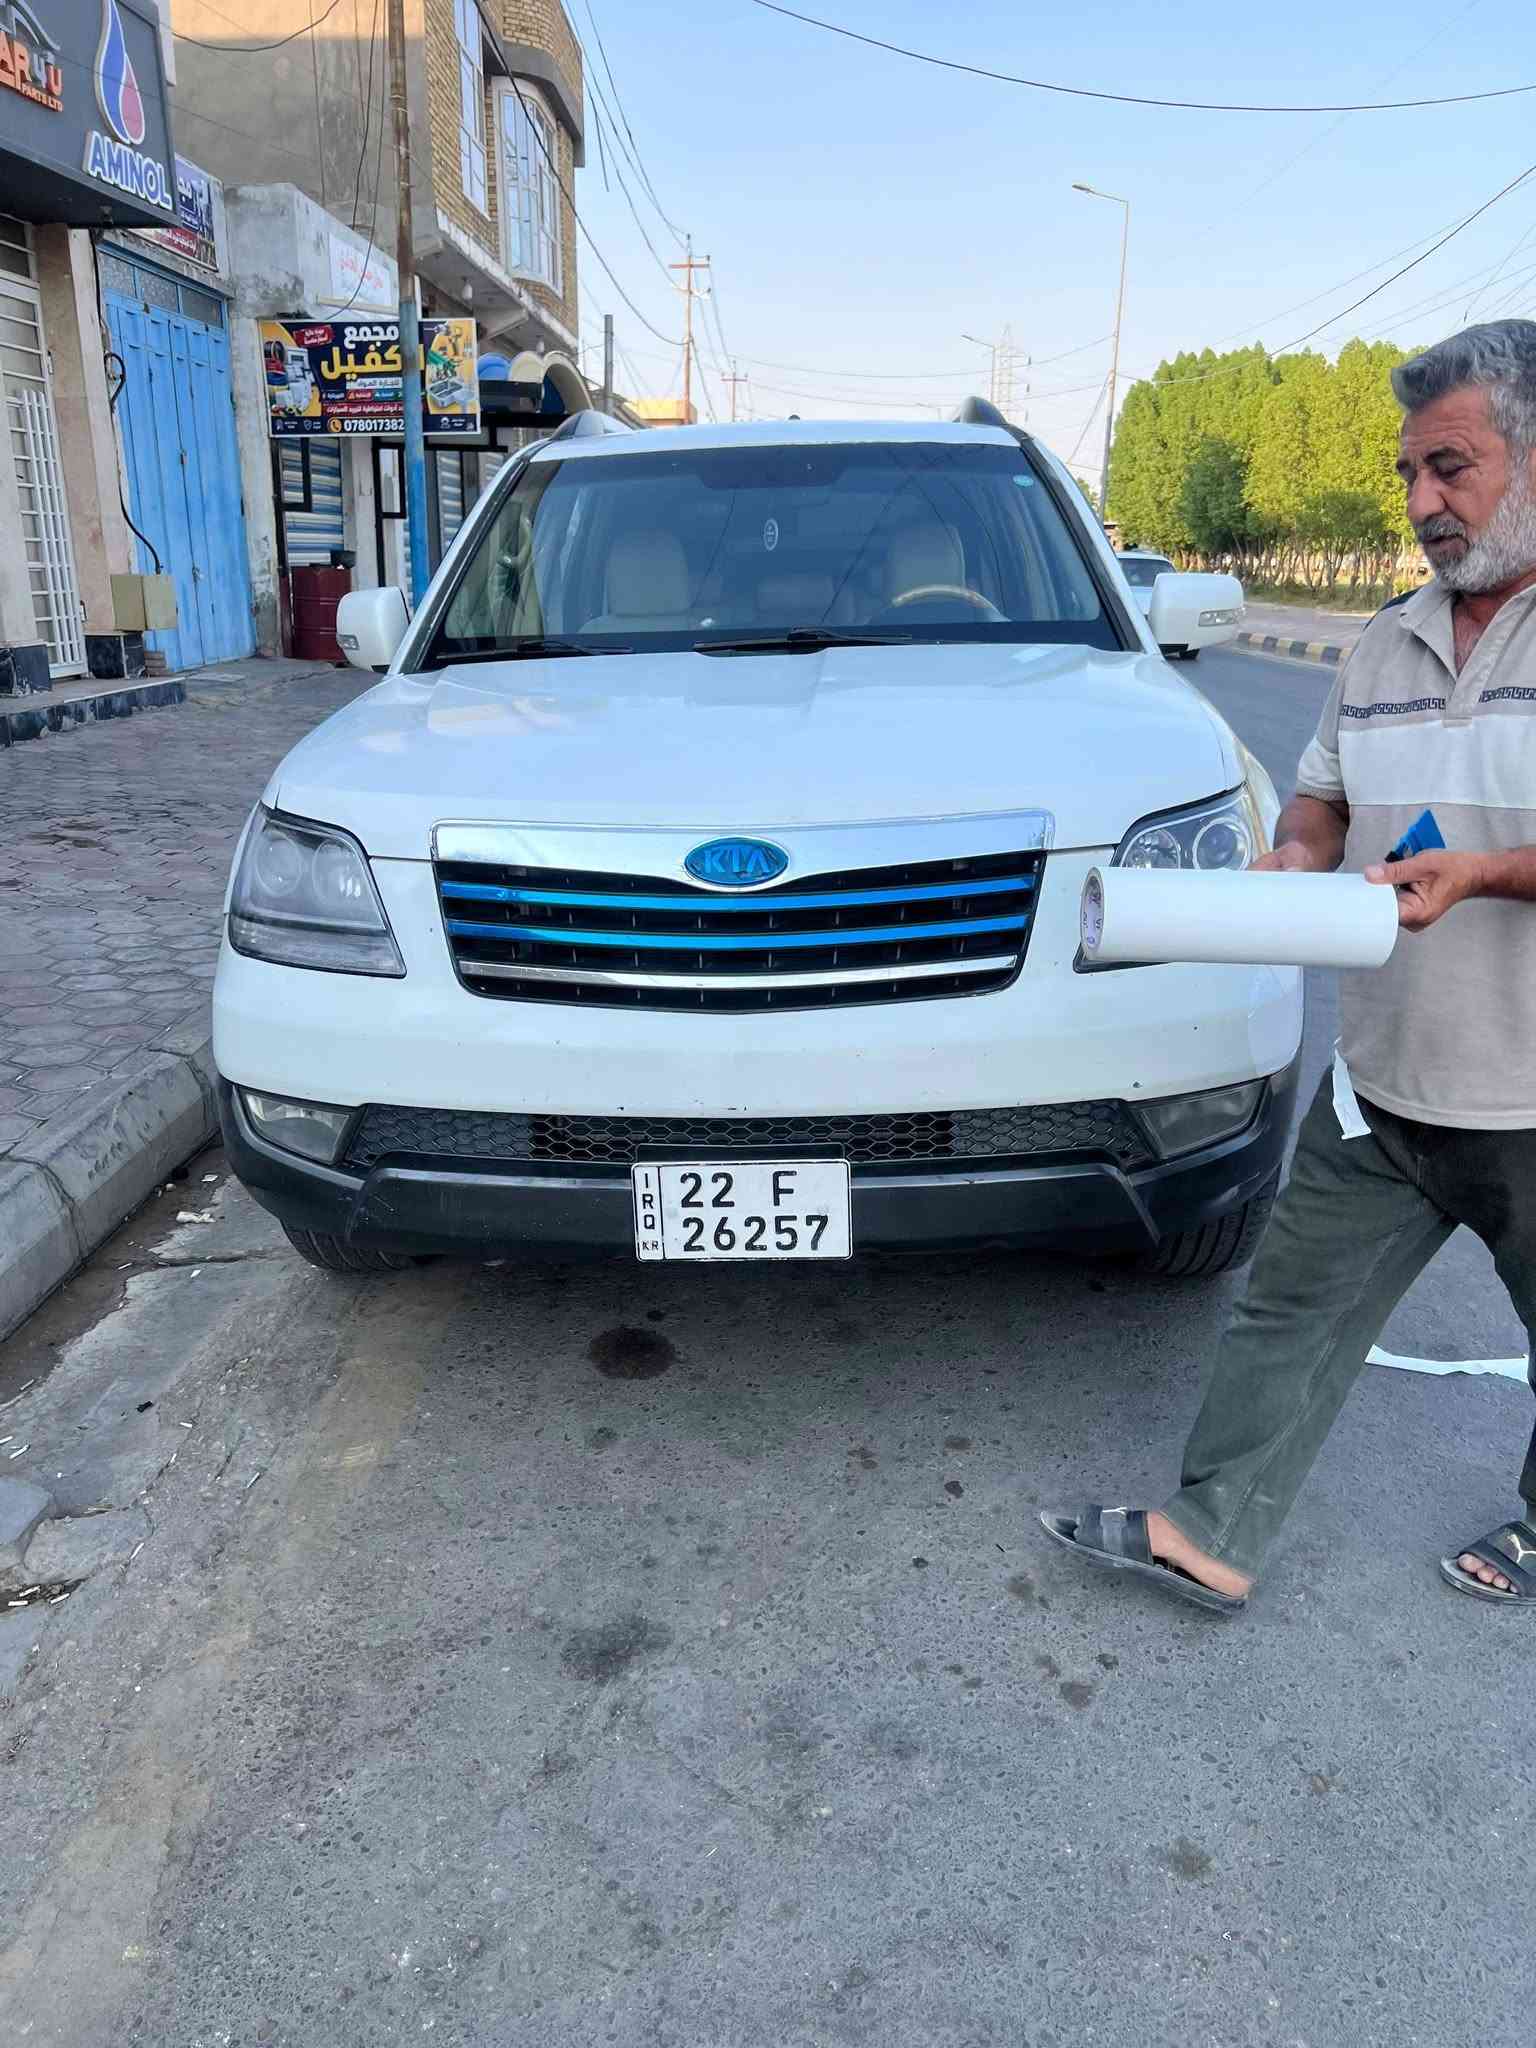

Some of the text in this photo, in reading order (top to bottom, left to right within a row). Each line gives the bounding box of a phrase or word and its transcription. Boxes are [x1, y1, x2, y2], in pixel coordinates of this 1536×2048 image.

[85, 129, 174, 211] AMINOL
[344, 325, 399, 349] مجمع
[320, 343, 425, 380] اكفيل
[343, 419, 405, 432] 078017382
[703, 844, 771, 873] KIA
[680, 1170, 798, 1208] 22 F
[641, 1240, 659, 1251] KR
[682, 1214, 829, 1251] 26257
